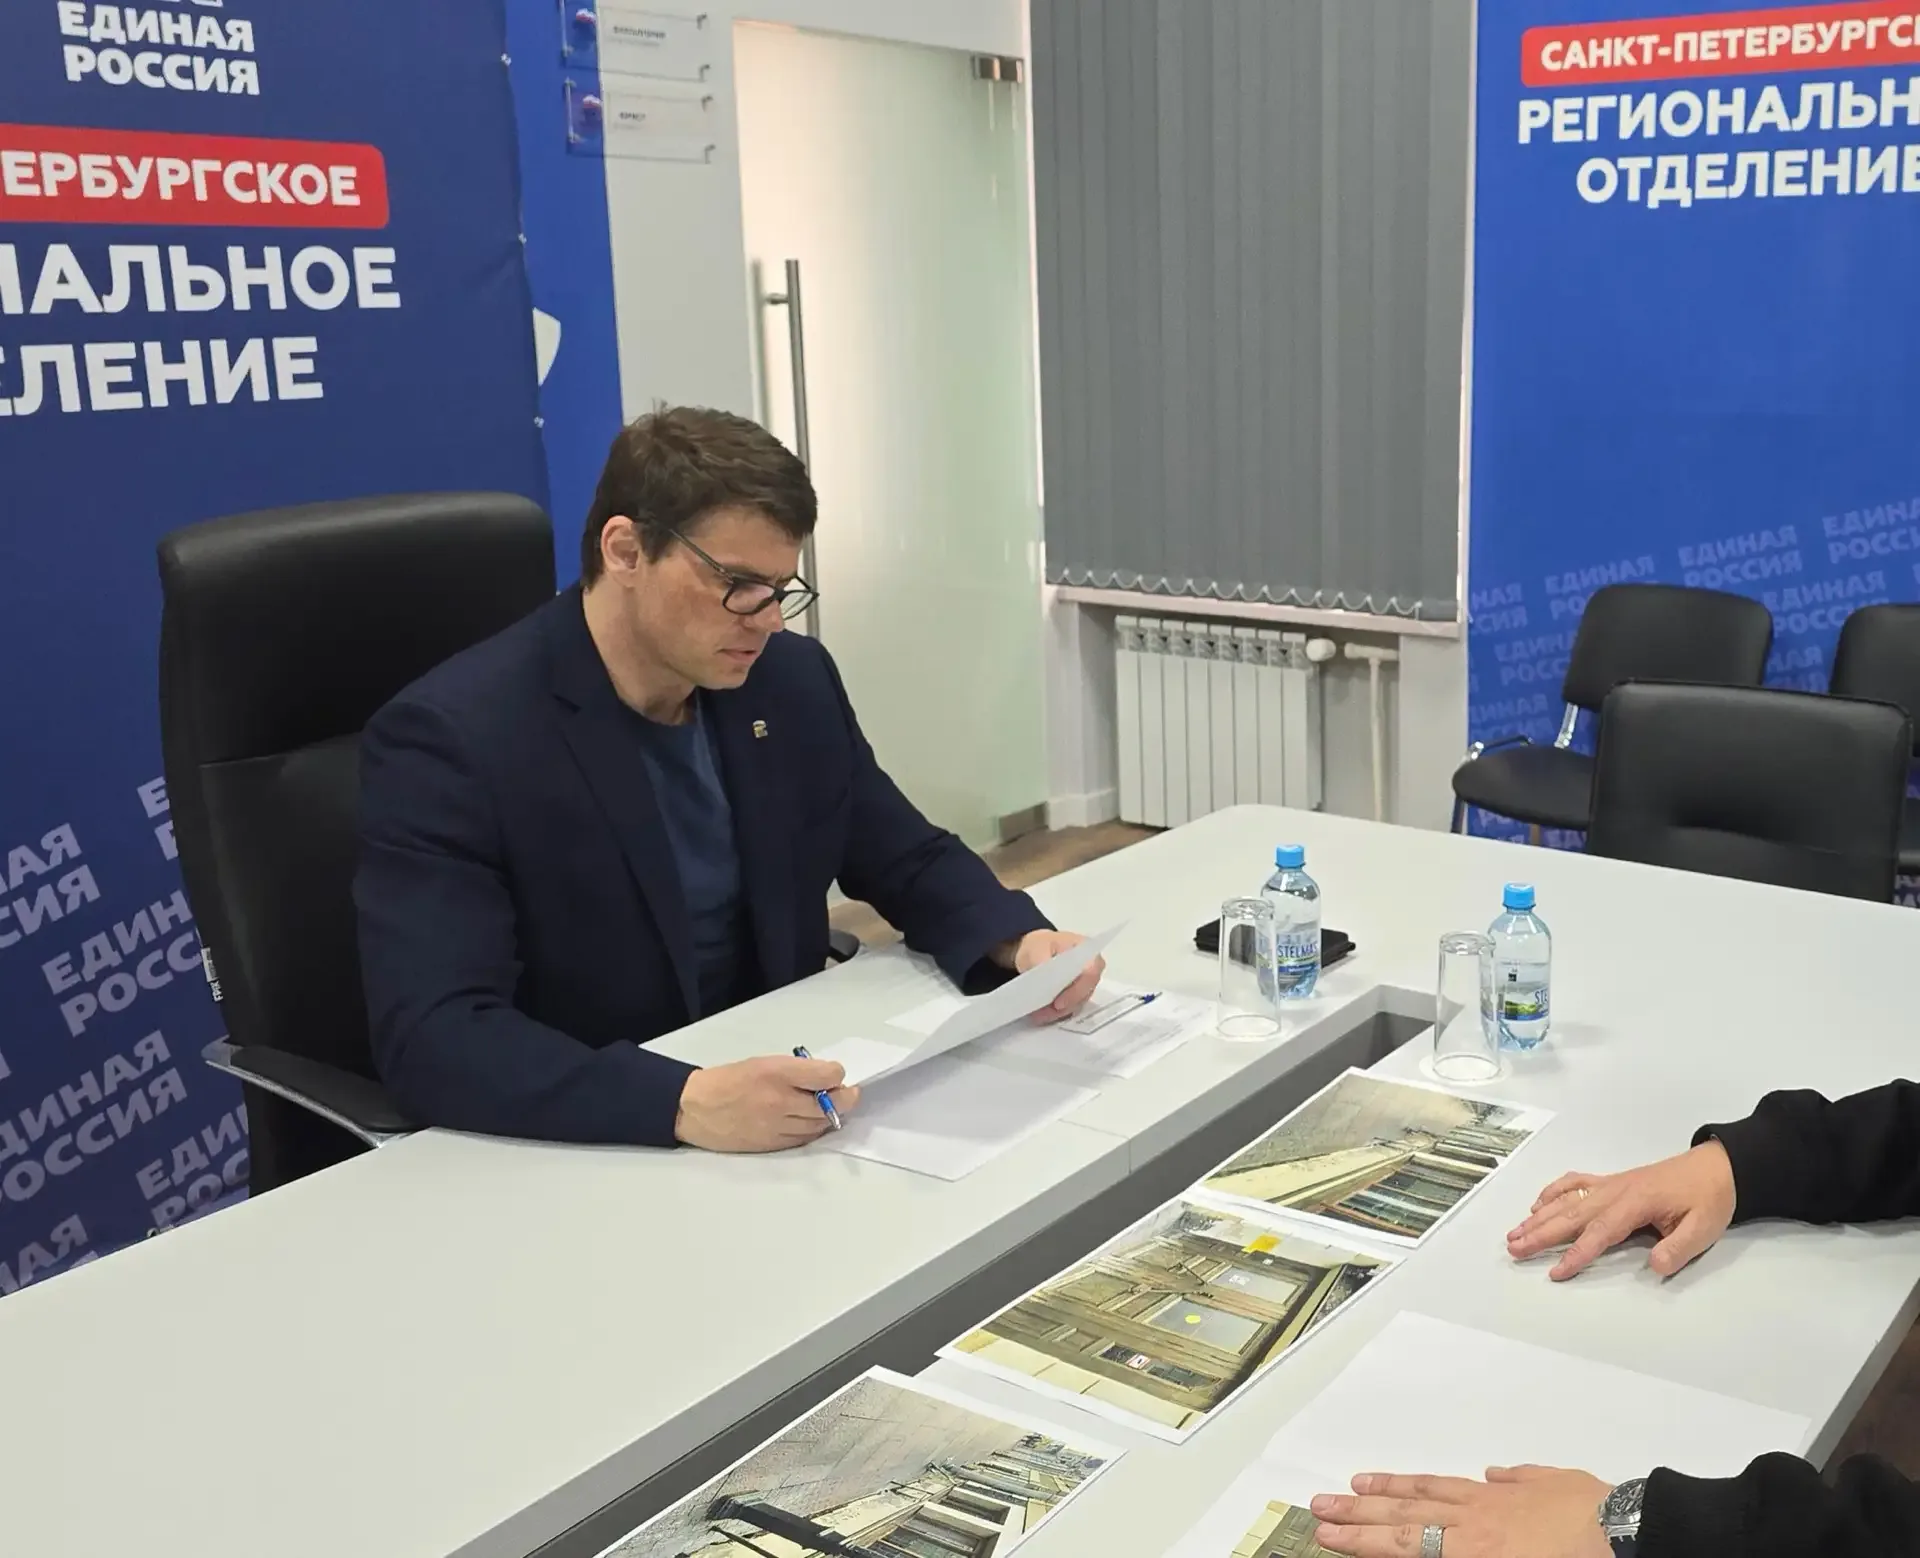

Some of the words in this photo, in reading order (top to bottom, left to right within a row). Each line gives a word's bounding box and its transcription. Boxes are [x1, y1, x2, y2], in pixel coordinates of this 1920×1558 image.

[57, 1, 255, 53] ЕДИНАЯ
[1541, 14, 1920, 72] САНКТ-ПЕТЕРБУРГС
[63, 45, 260, 96] РОССИЯ
[1518, 77, 1920, 144] РЕГИОНАЛЬН
[0, 150, 361, 207] ЕРБУРГСКОЕ
[1677, 524, 1798, 568] ЕДИНАЯ
[1544, 555, 1655, 595] ЕДИНАЯ
[1774, 597, 1889, 639] РОСС
[0, 822, 82, 895] АЯ
[0, 1067, 188, 1202] ОССИЯ
